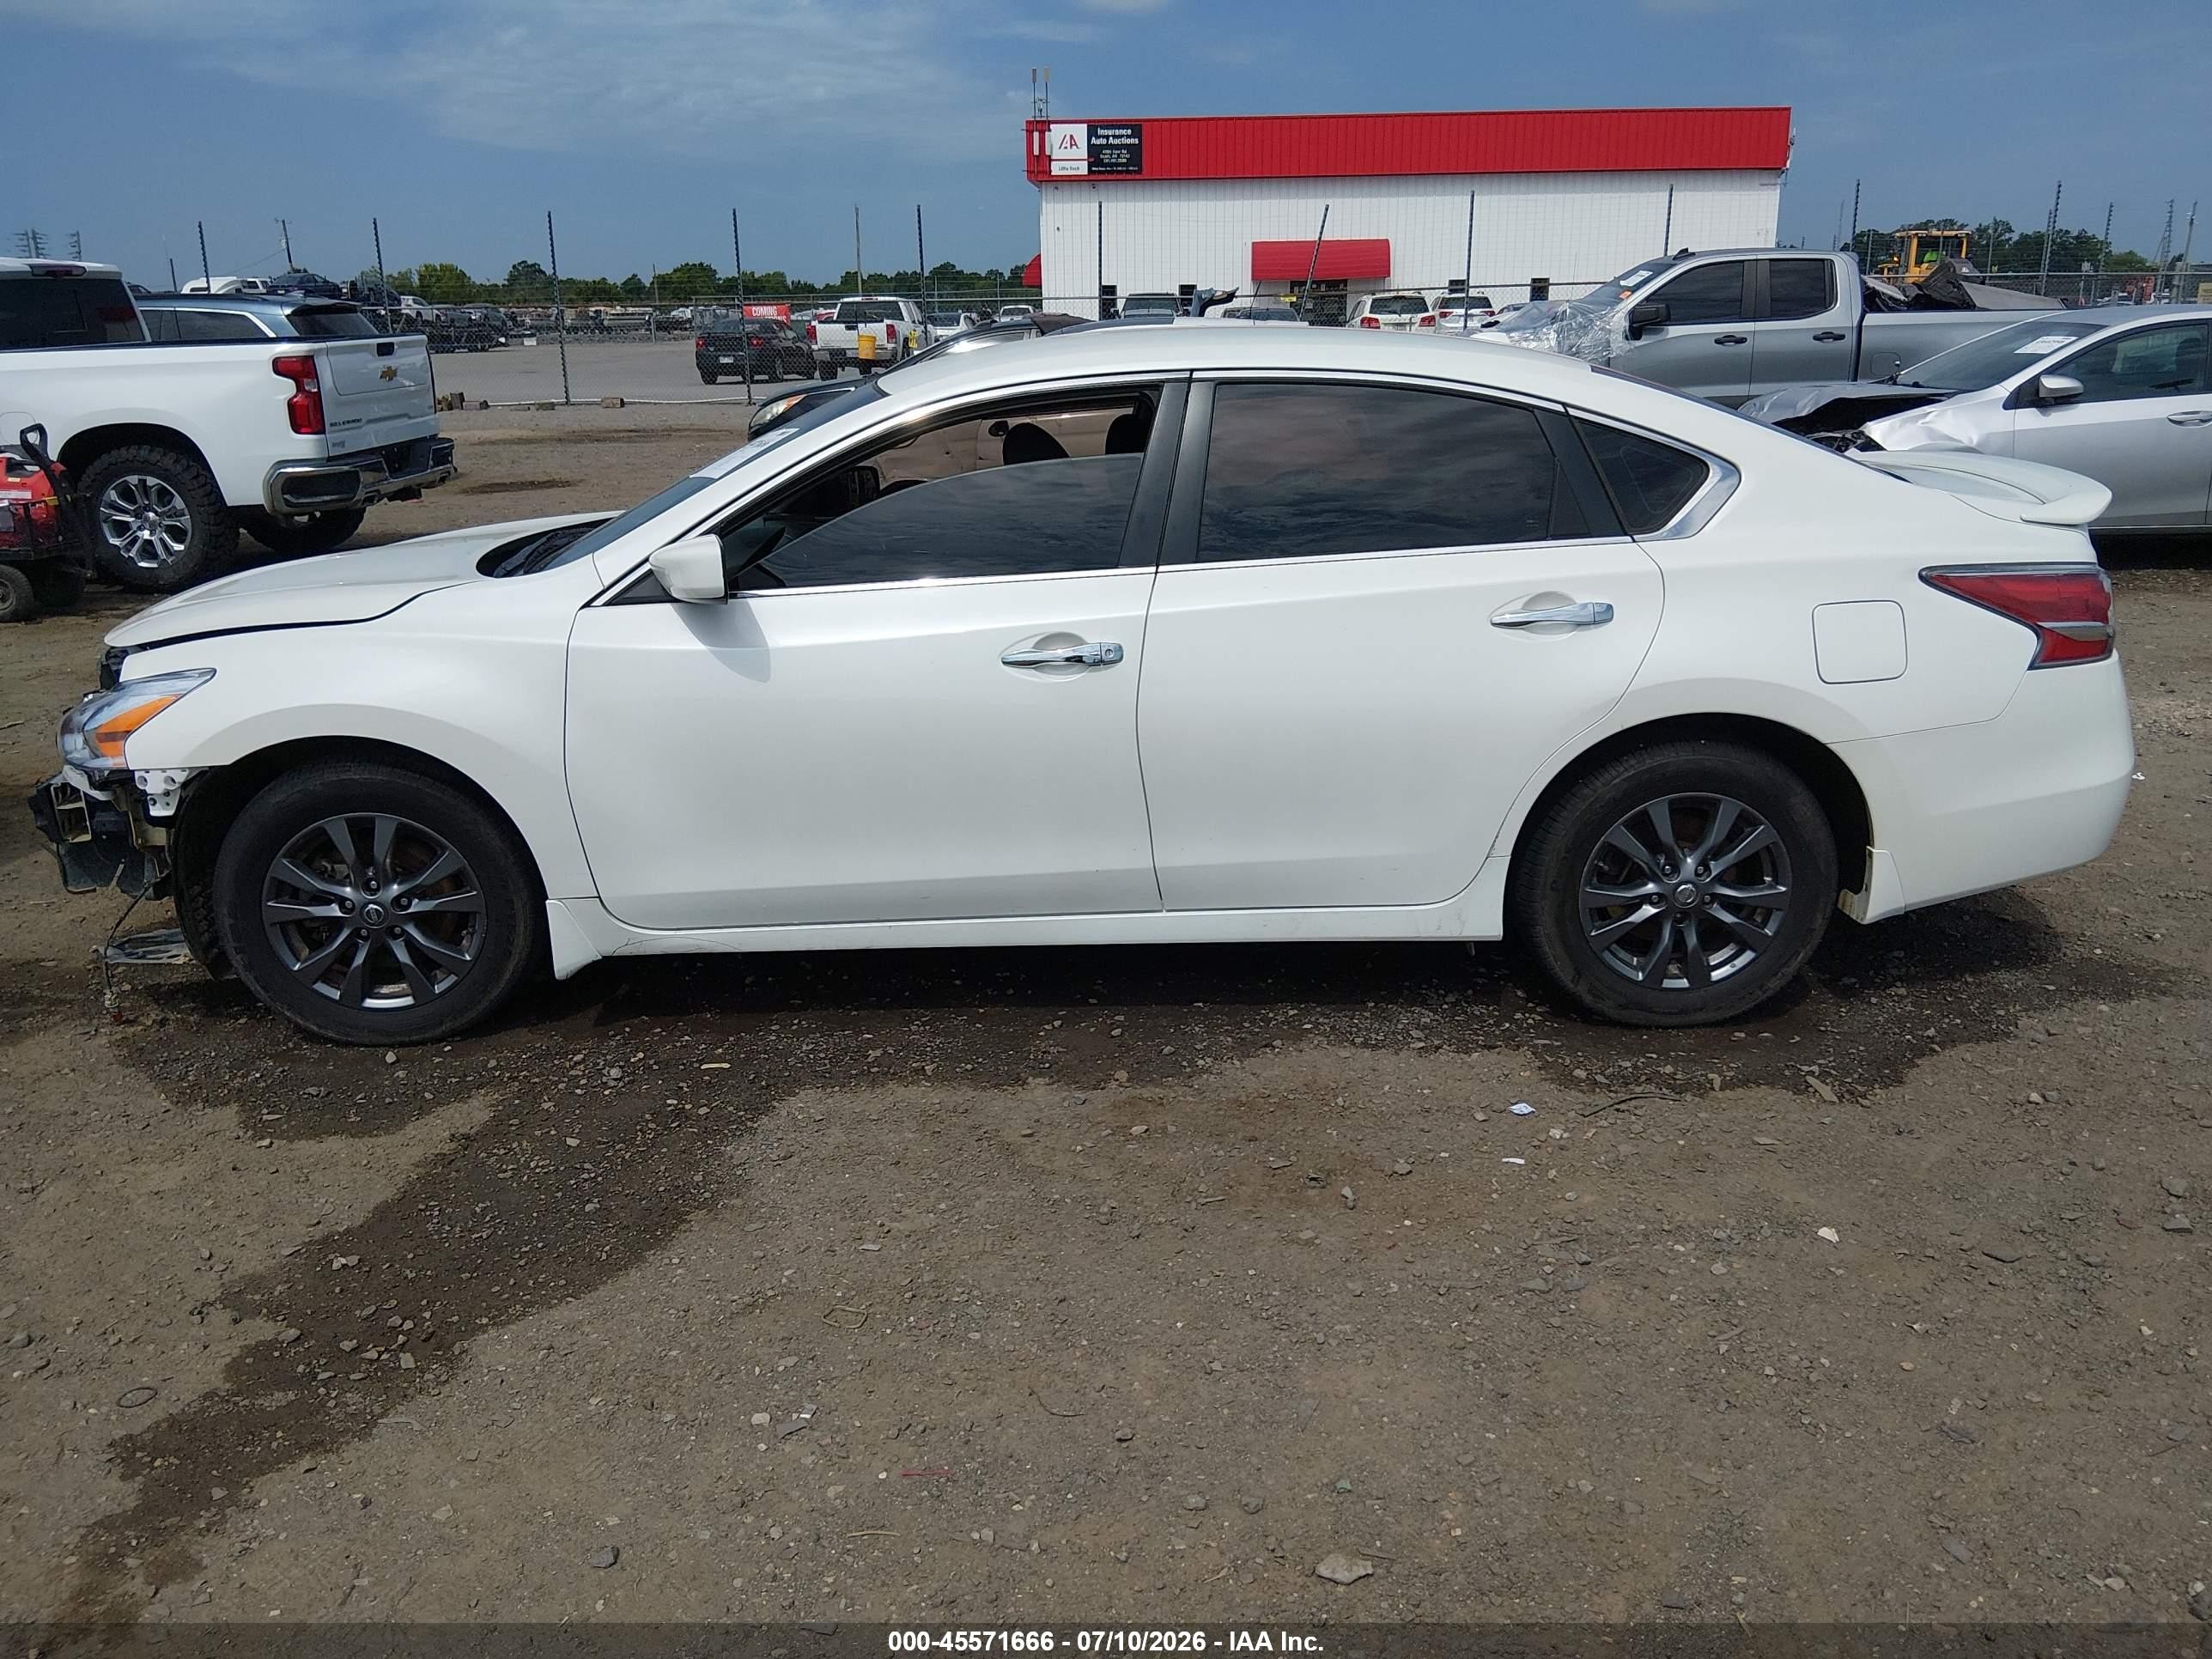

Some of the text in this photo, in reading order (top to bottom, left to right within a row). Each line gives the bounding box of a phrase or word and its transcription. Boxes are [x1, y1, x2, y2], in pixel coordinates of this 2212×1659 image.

[1097, 127, 1132, 136] Insurance
[1108, 136, 1139, 145] Auctions
[751, 306, 778, 317] COMING
